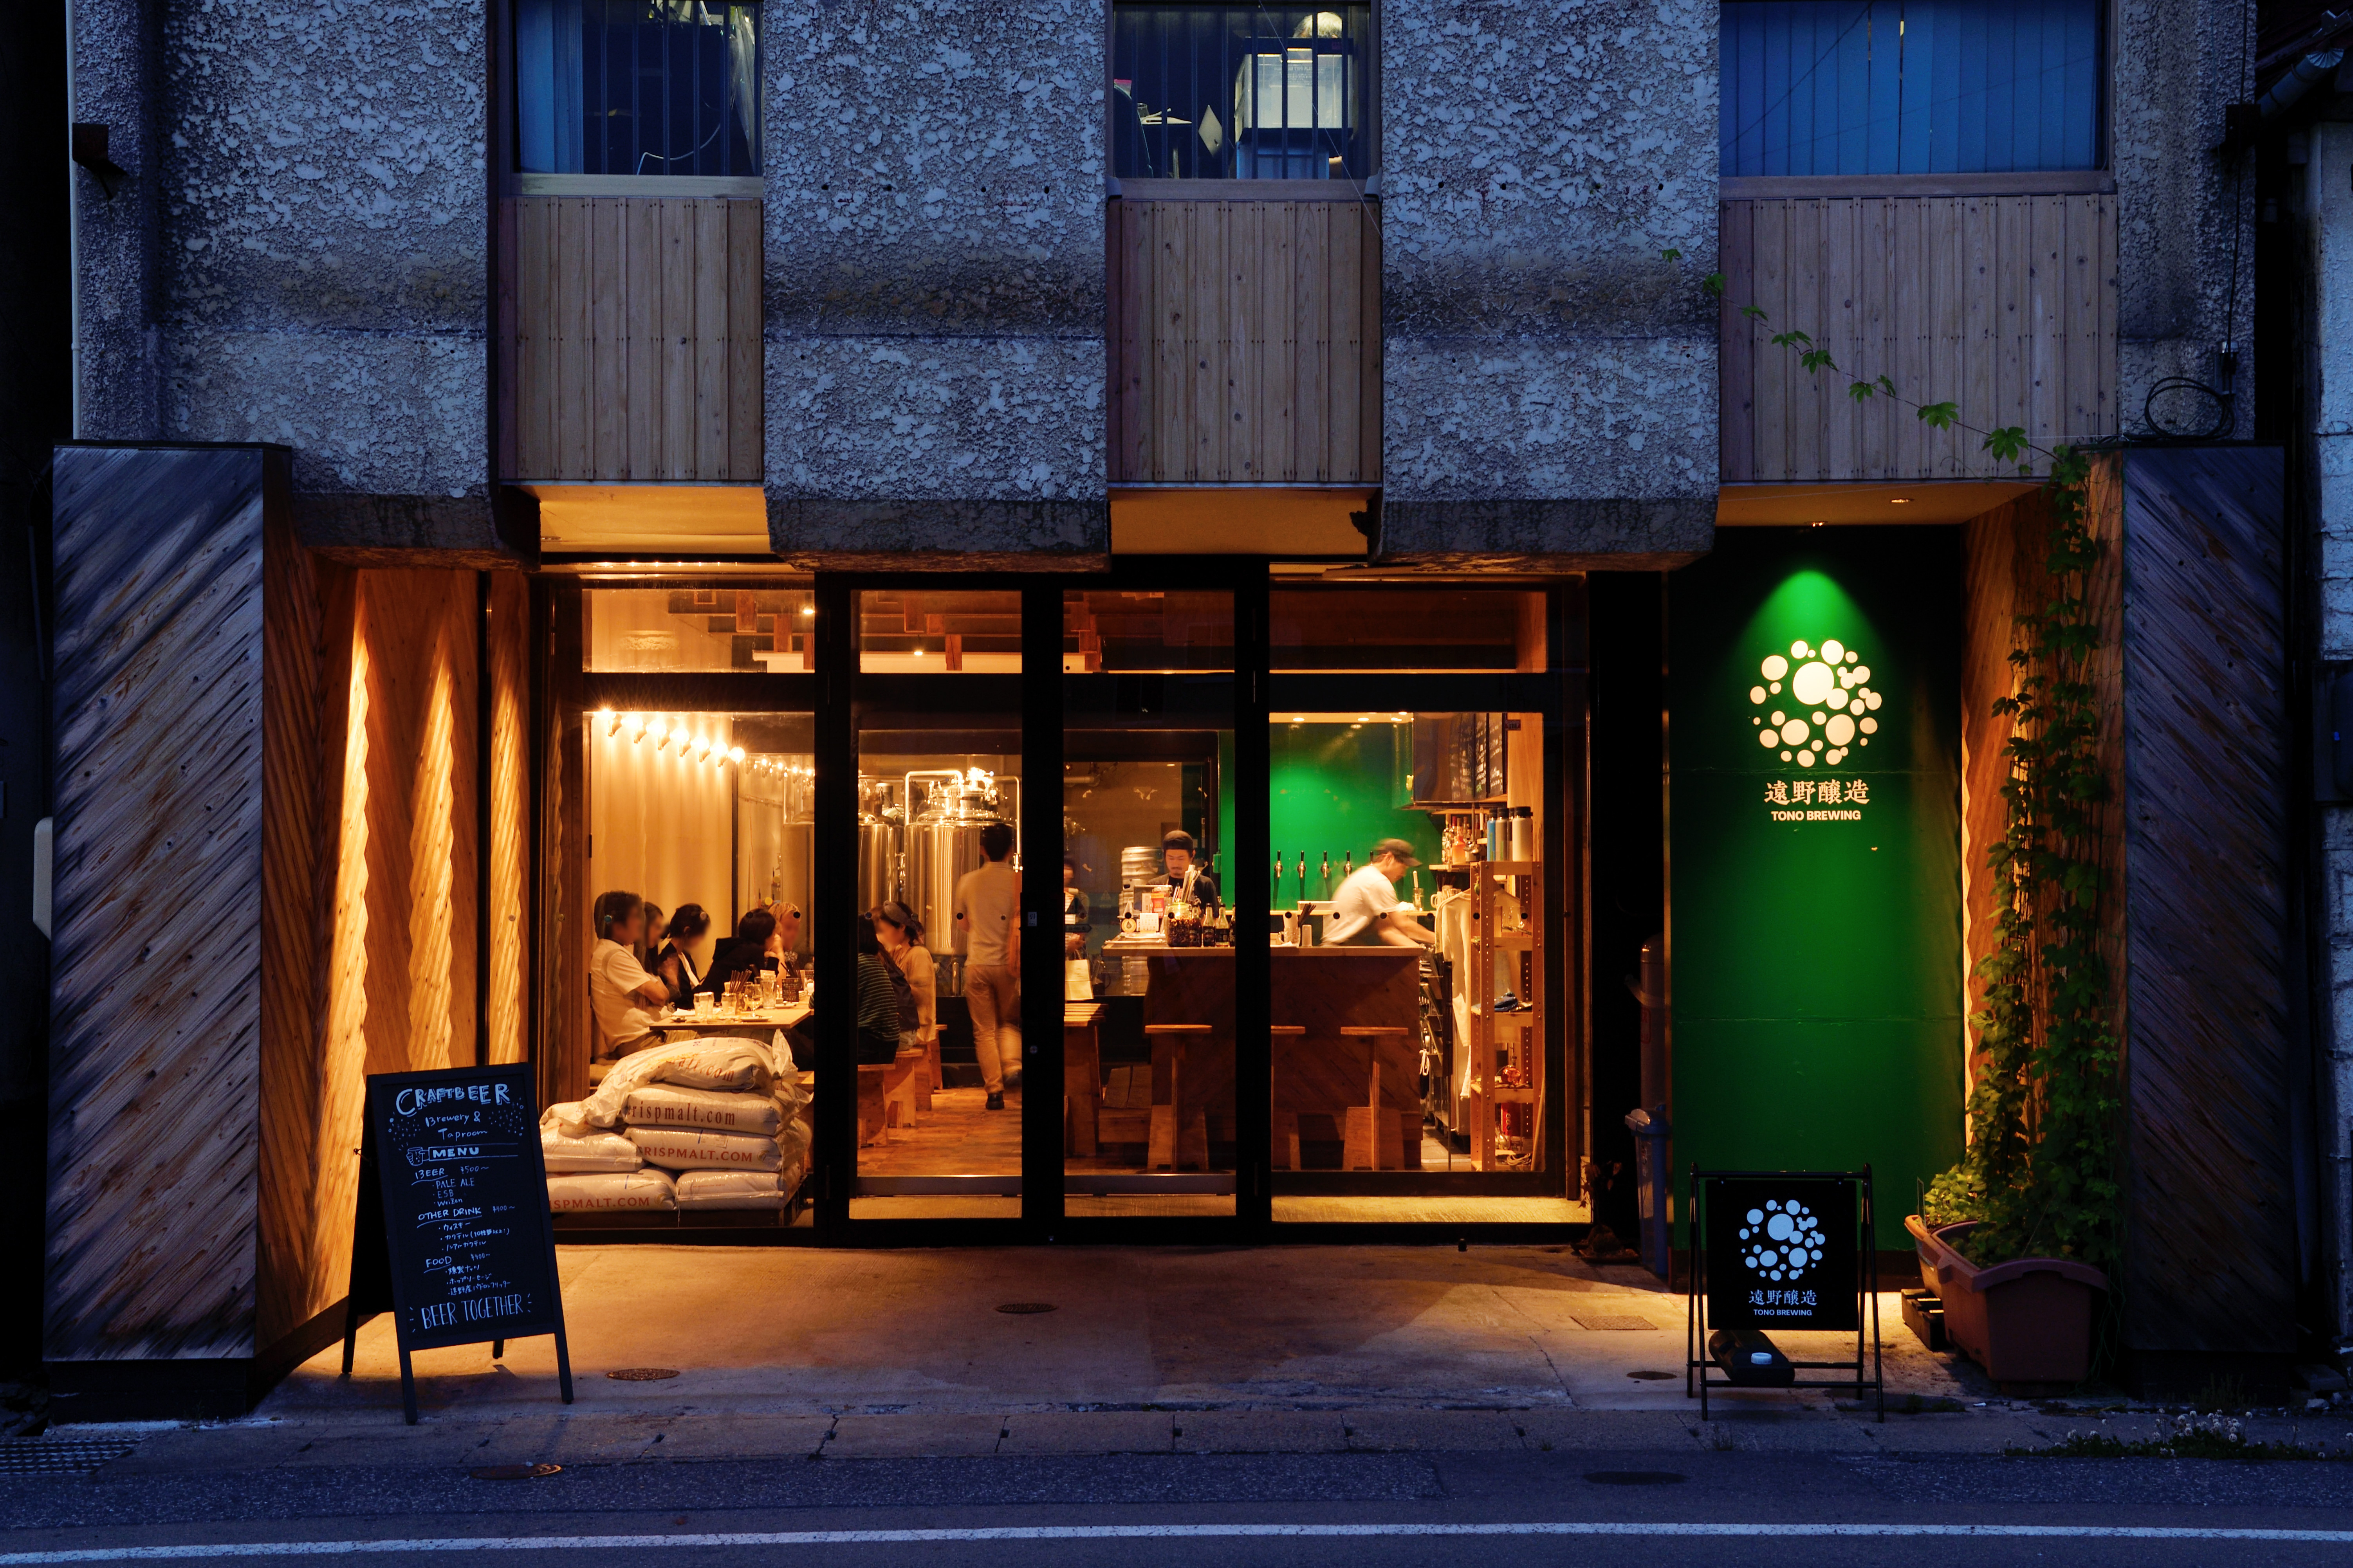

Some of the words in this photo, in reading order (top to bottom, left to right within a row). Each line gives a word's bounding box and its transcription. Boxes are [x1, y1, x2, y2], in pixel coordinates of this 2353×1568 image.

[1764, 779, 1870, 806] 遠野醸造
[1771, 811, 1804, 821] TONO
[1807, 810, 1861, 821] BREWING
[425, 1114, 469, 1128] Brewery
[474, 1111, 481, 1122] &
[438, 1128, 488, 1141] Taproom
[433, 1147, 479, 1158] MENU
[415, 1168, 445, 1179] BEER
[436, 1179, 456, 1190] PALE
[460, 1177, 475, 1187] ALE
[437, 1189, 454, 1199] ESB
[418, 1209, 449, 1220] OTHER
[453, 1207, 482, 1217] DRINK
[426, 1256, 452, 1268] FOOD
[1749, 1289, 1817, 1306] 遠野醸造
[421, 1302, 458, 1329] BEER
[461, 1294, 523, 1321] TOGETHER
